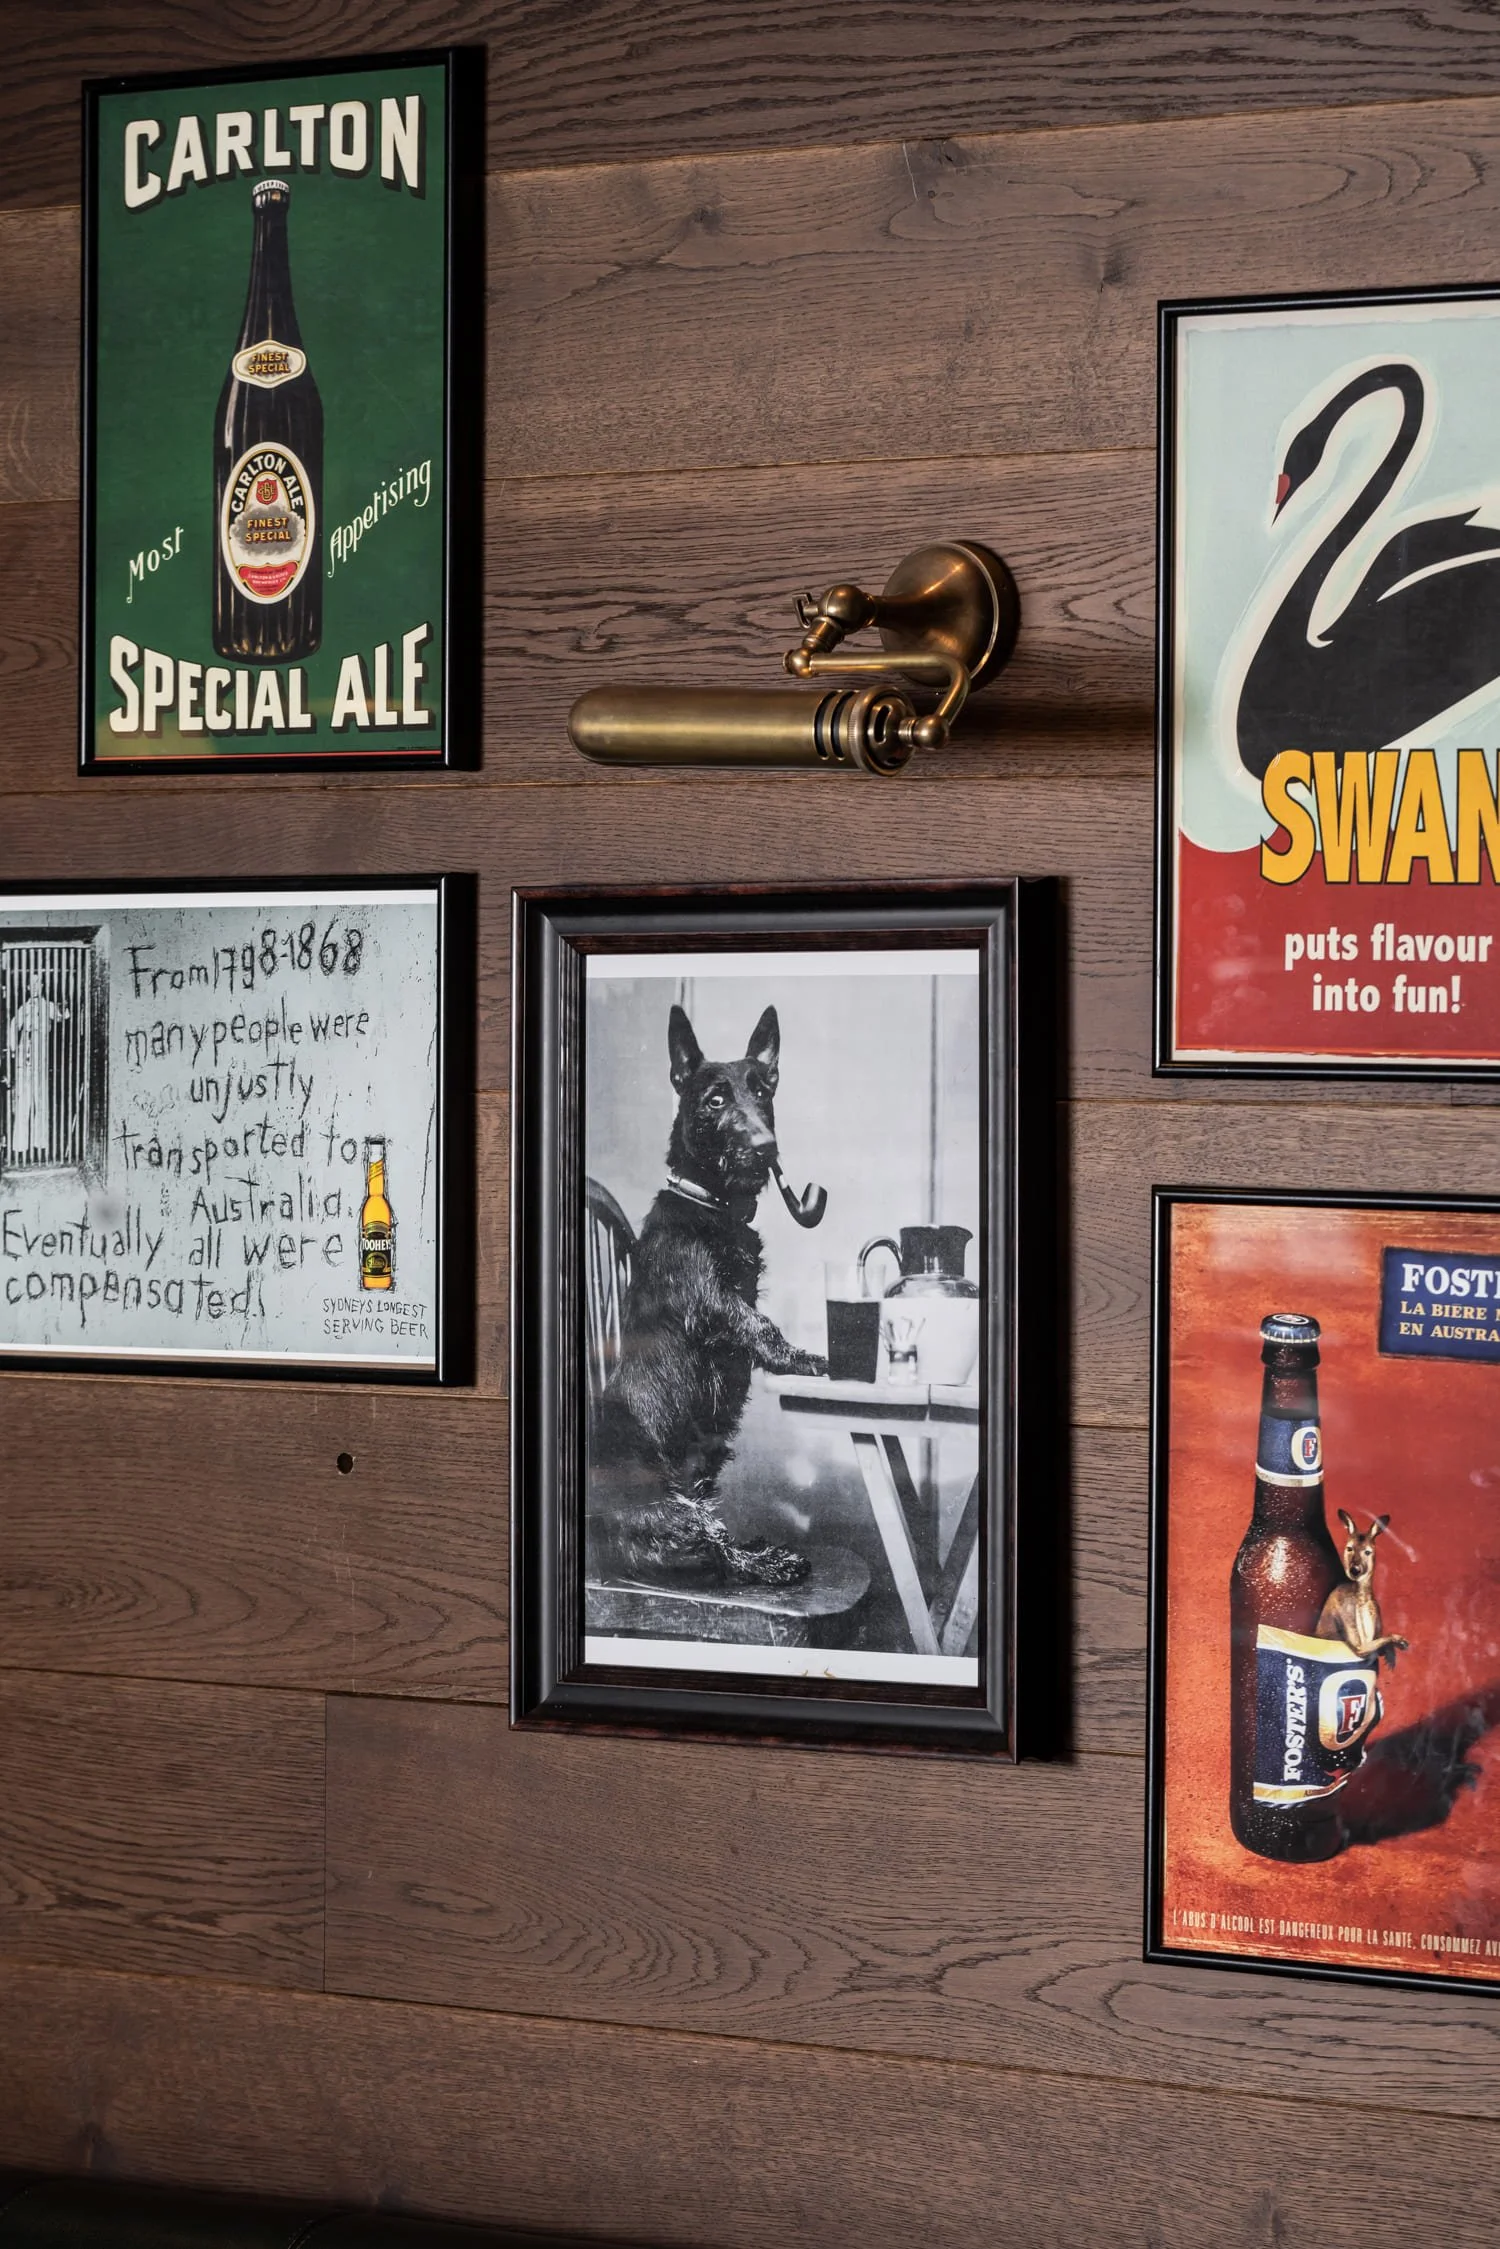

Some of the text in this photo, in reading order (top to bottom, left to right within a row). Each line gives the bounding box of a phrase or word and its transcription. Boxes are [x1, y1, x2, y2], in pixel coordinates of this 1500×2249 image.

[124, 96, 421, 207] CARLTON
[248, 363, 290, 373] SPECIAL
[251, 352, 288, 361] FINEST
[231, 453, 304, 513] CARLTON ALE
[245, 531, 291, 544] SPECIAL
[247, 517, 288, 530] FINEST
[327, 460, 431, 577] Appetising
[109, 622, 429, 732] SPECIAL ALE
[1260, 748, 1500, 885] SWAN
[1285, 923, 1492, 970] puts flavour
[1313, 973, 1461, 1014] into fun!
[212, 996, 303, 1067] people
[308, 1008, 369, 1042] were
[189, 1055, 313, 1124] unjustly
[113, 1110, 358, 1186] transported to
[2, 1200, 343, 1271] Eventually all were
[323, 1318, 429, 1341] SERVING BEER
[377, 1299, 428, 1318] LONGEST
[1400, 1301, 1426, 1316] LA
[1400, 1322, 1424, 1336] EN
[1259, 1918, 1275, 1934] EST
[1280, 1921, 1333, 1941] DANGEREUX
[1338, 1926, 1362, 1944] POUR
[1367, 1929, 1378, 1945] LA
[1421, 1934, 1481, 1956] CONSOMMEZ
